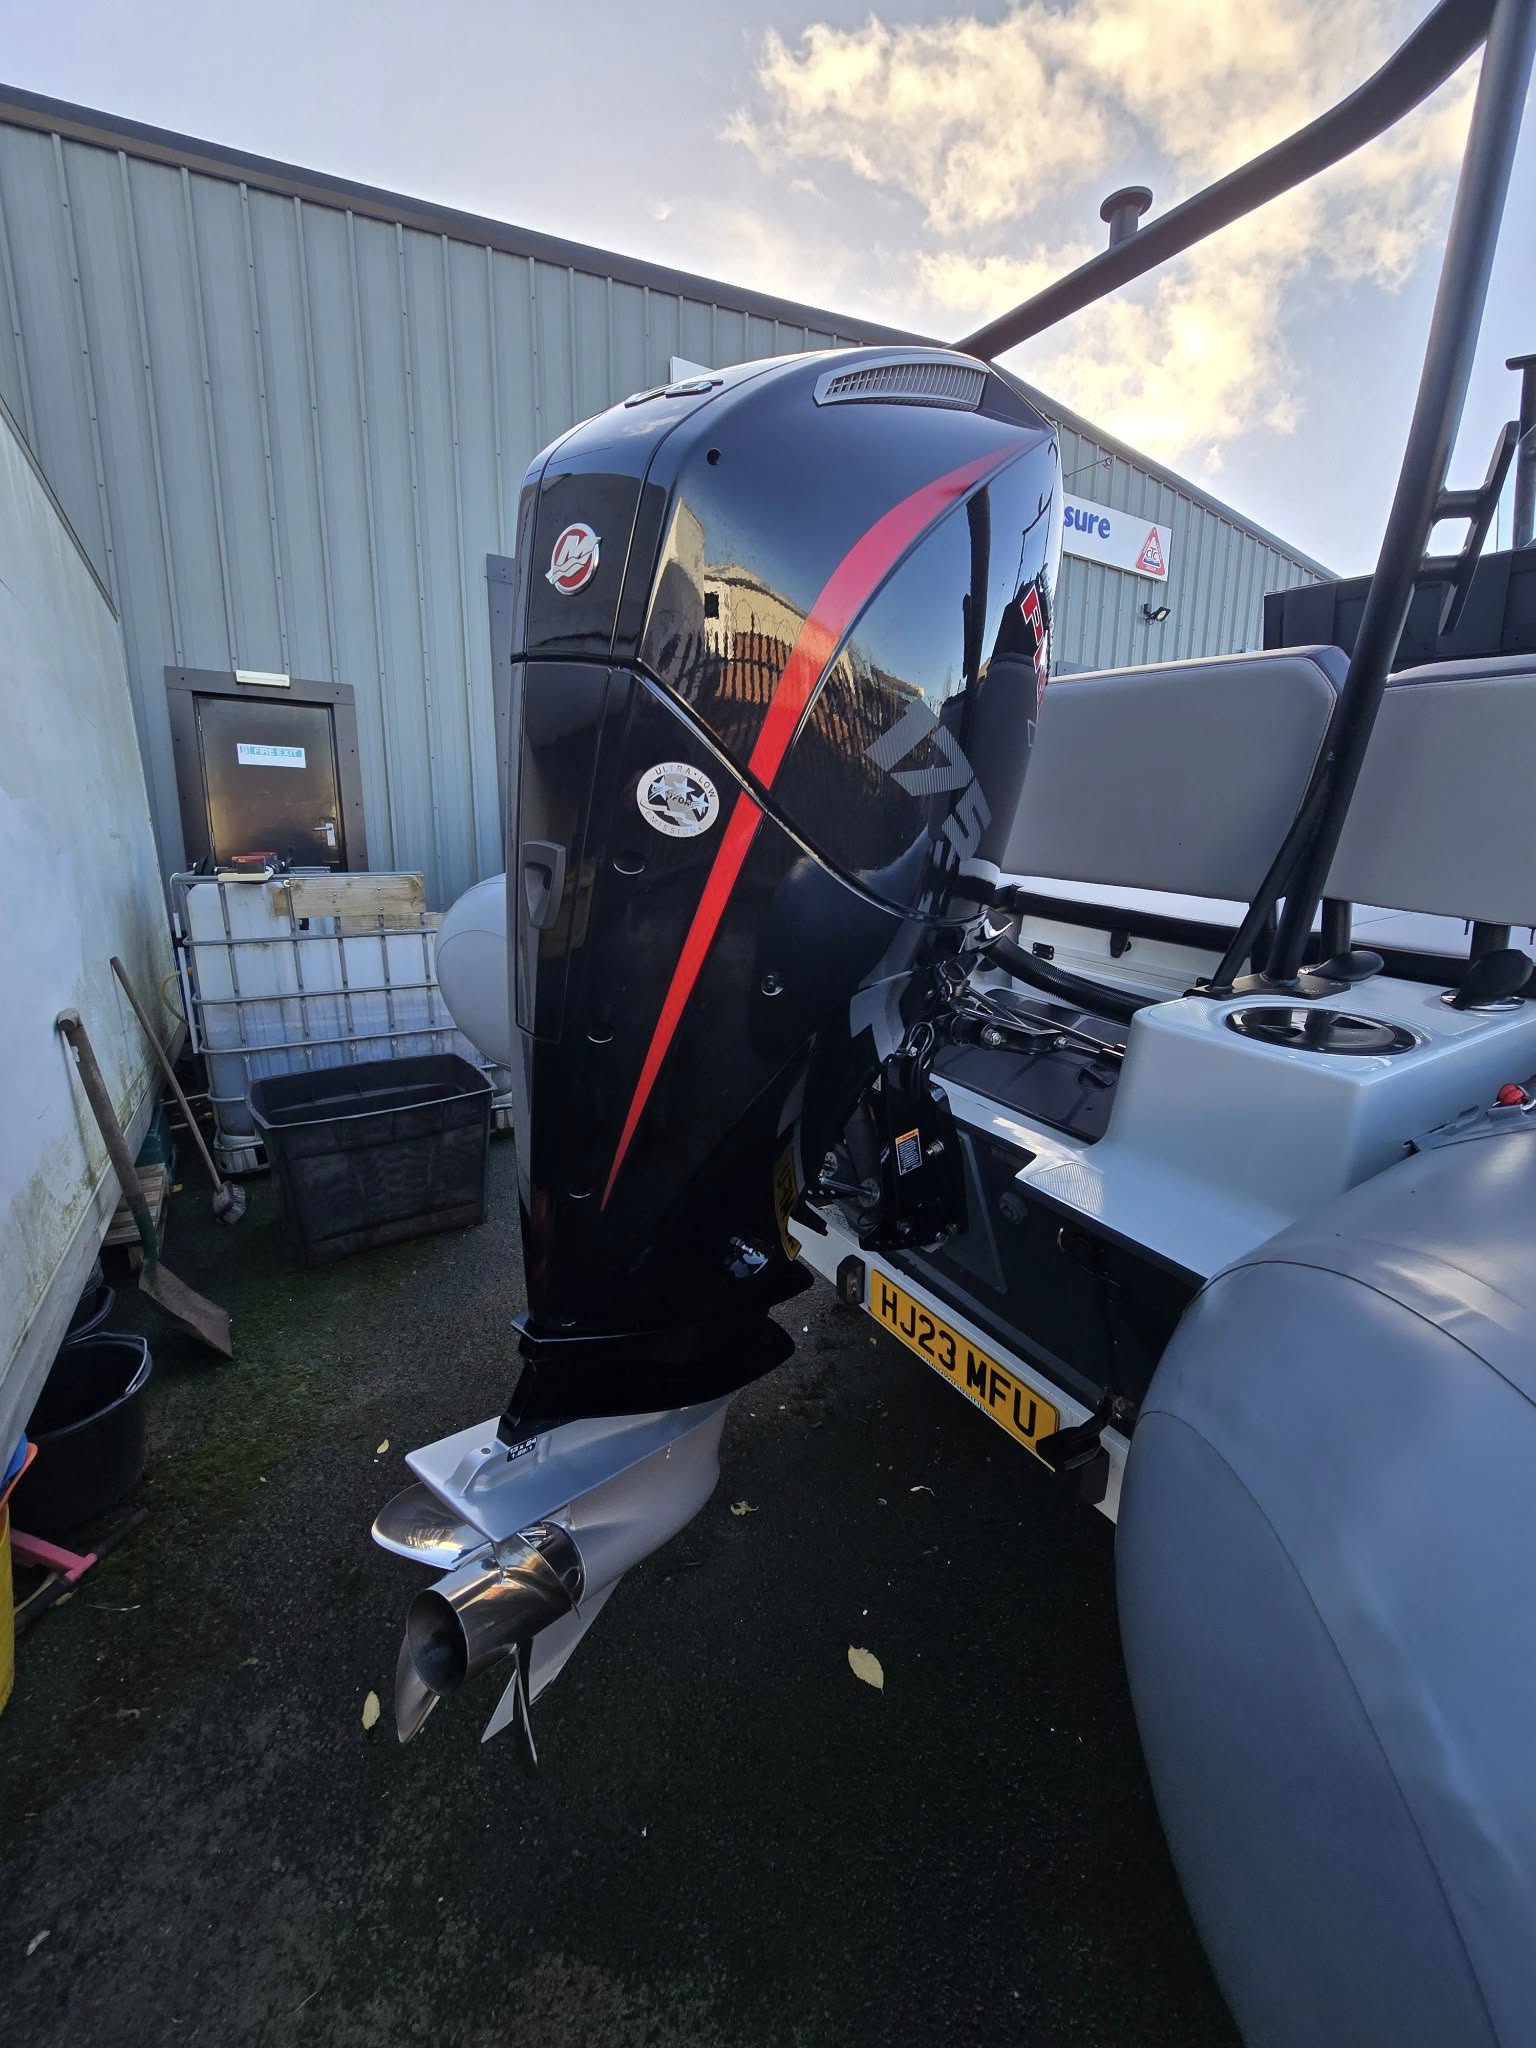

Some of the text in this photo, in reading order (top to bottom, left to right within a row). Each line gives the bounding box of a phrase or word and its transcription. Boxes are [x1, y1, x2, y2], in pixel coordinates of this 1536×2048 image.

[1146, 546, 1159, 560] CTC
[253, 747, 298, 757] FIRE EXIT
[655, 764, 691, 775] ULTRA
[698, 775, 717, 798] LOW
[864, 696, 992, 861] 175
[645, 811, 696, 835] EMISSION
[881, 1283, 957, 1372] HJ23
[966, 1349, 1037, 1438] MFU
